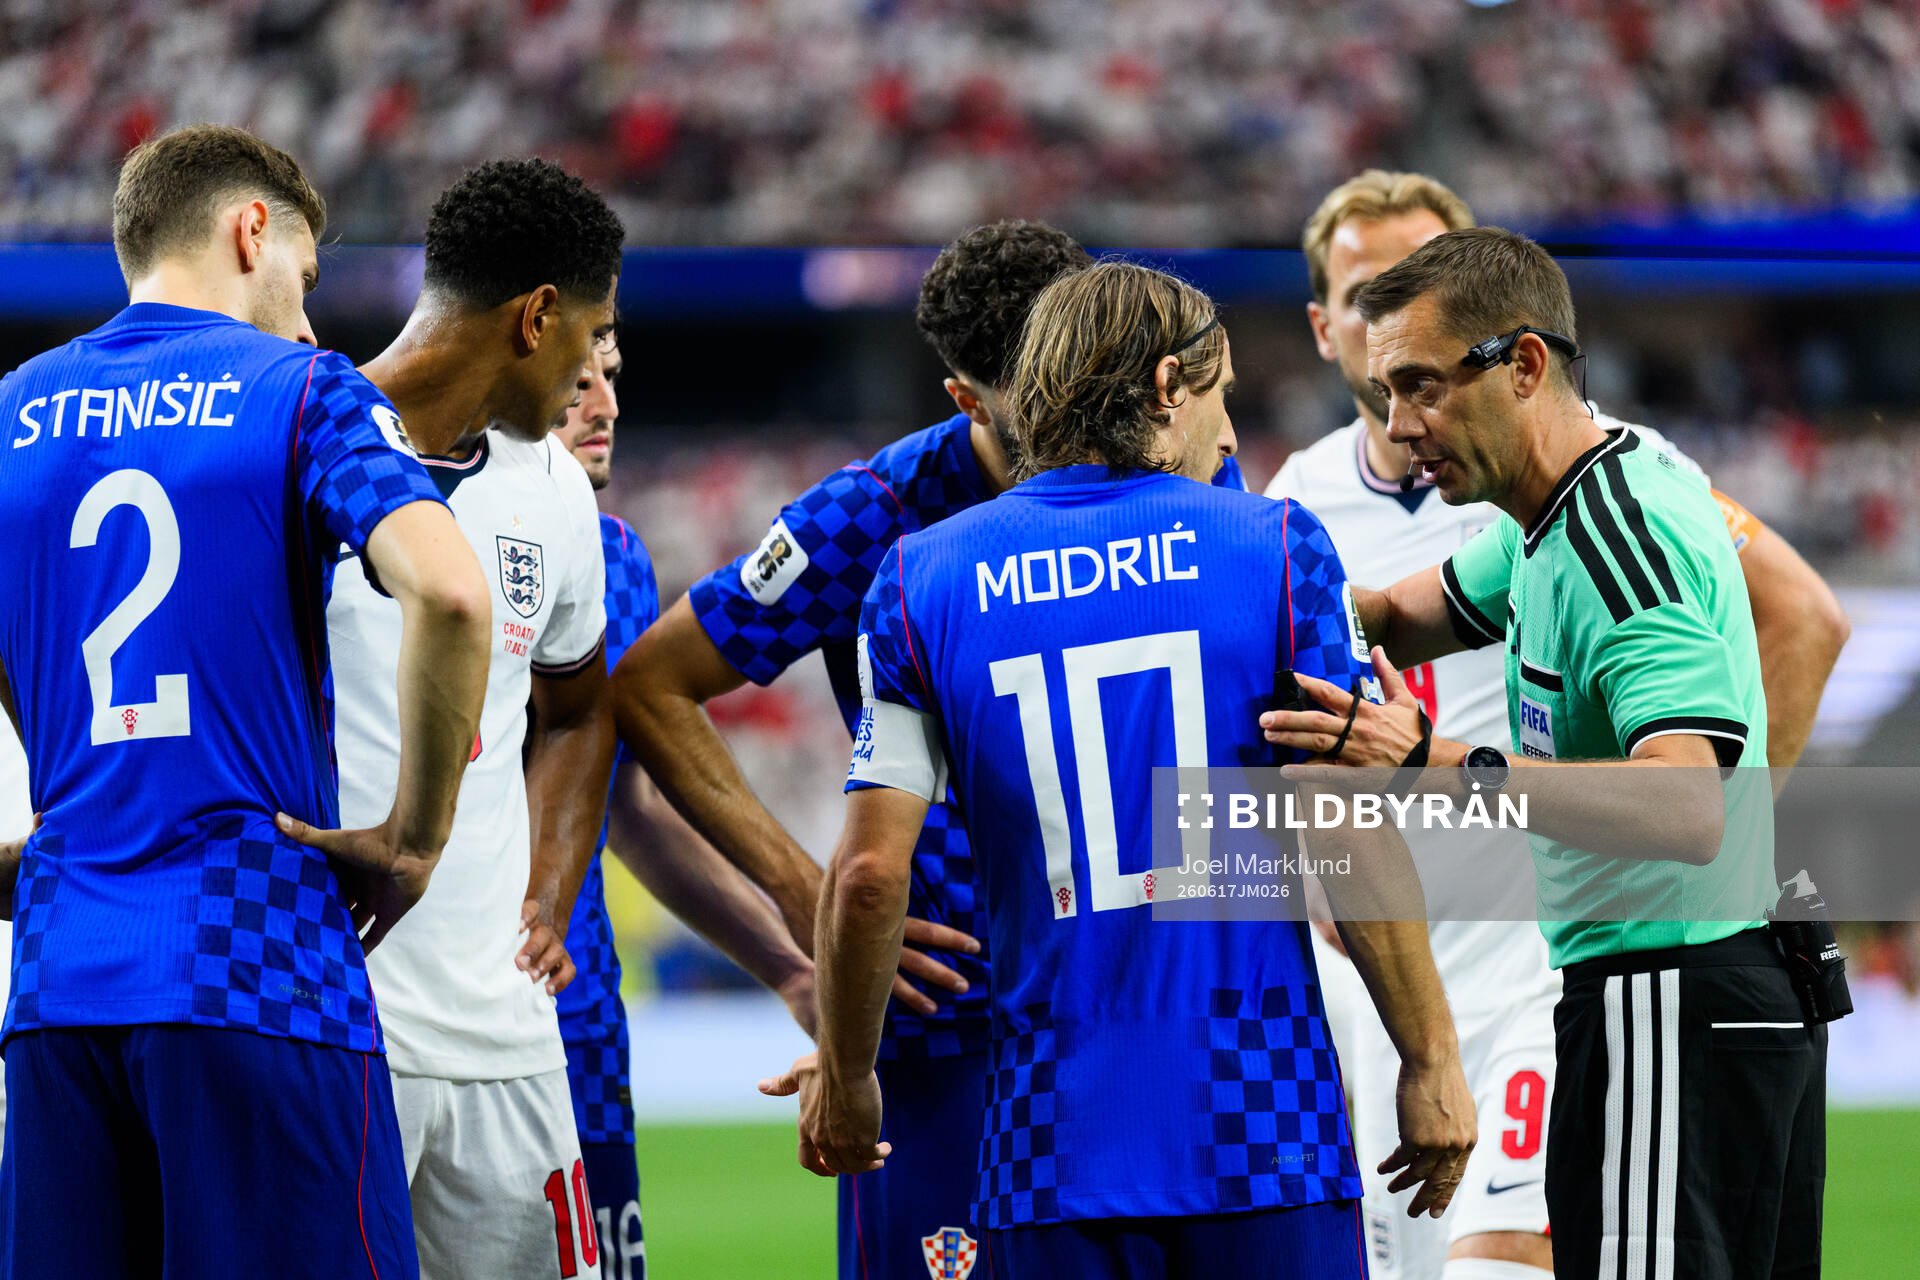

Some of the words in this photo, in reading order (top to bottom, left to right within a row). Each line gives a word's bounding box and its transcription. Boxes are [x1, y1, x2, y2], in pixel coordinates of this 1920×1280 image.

[70, 468, 191, 746] 2
[976, 520, 1199, 613] MODRIĆ
[1521, 700, 1551, 737] FIFA
[989, 630, 1211, 920] 10
[1501, 1070, 1546, 1160] 9
[544, 1158, 598, 1279] 10
